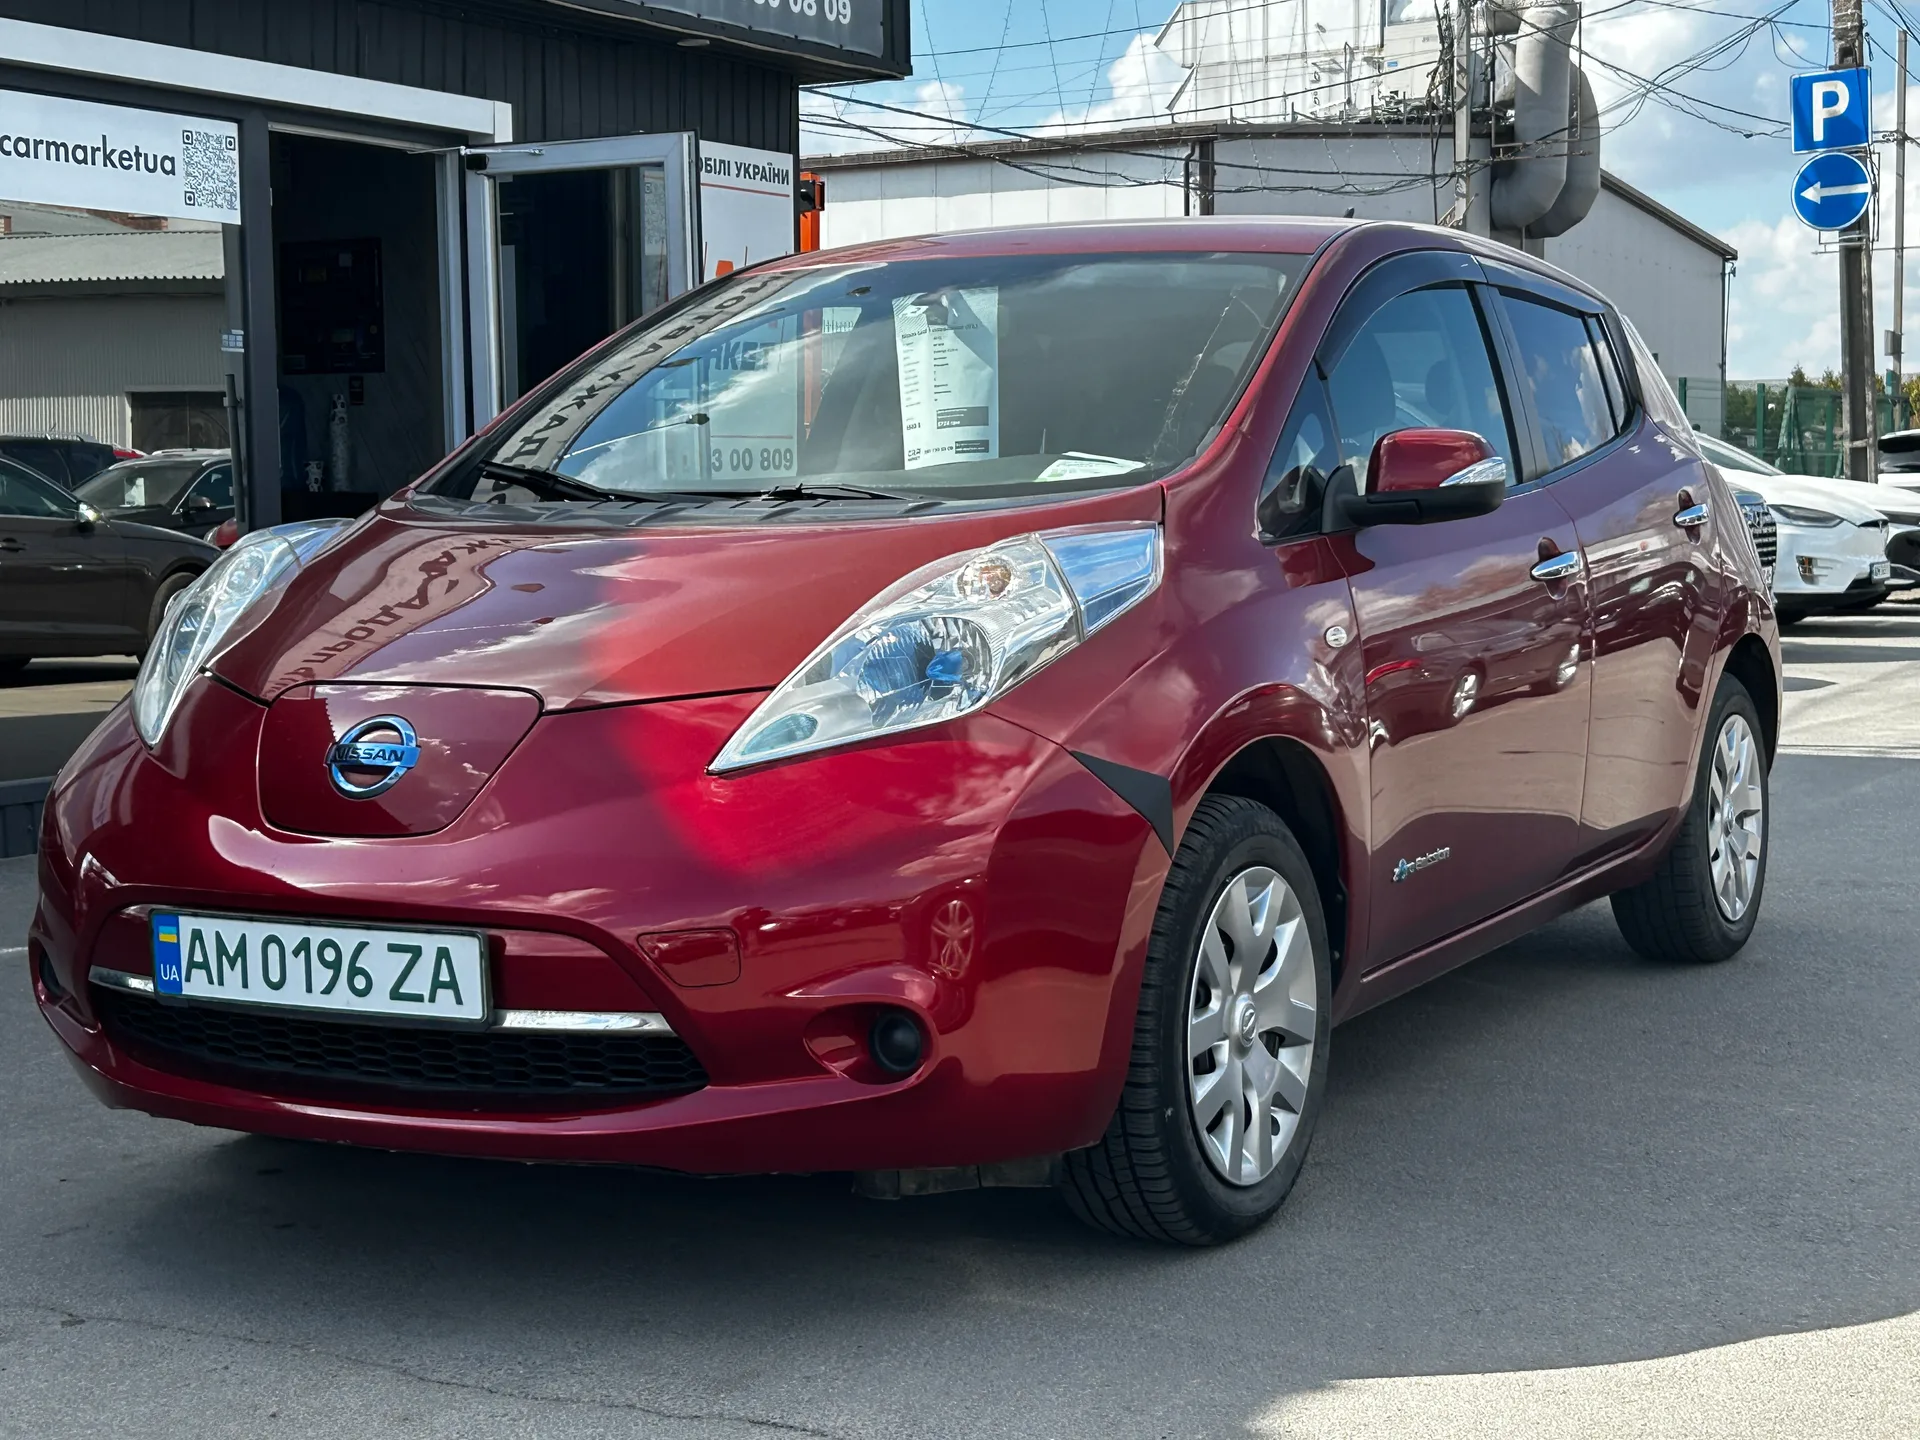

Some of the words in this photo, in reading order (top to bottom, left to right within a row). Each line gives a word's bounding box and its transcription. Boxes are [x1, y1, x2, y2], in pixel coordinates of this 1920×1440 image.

[824, 0, 851, 24] 09
[1812, 80, 1849, 142] P
[0, 134, 176, 176] carmarketua
[735, 161, 790, 186] УКРАЇНИ
[729, 448, 753, 472] 00
[759, 447, 794, 472] 809
[334, 746, 405, 763] NISSAN
[161, 963, 180, 982] UA
[185, 928, 249, 989] AM
[261, 934, 373, 998] 0196
[387, 944, 464, 1006] ZA
